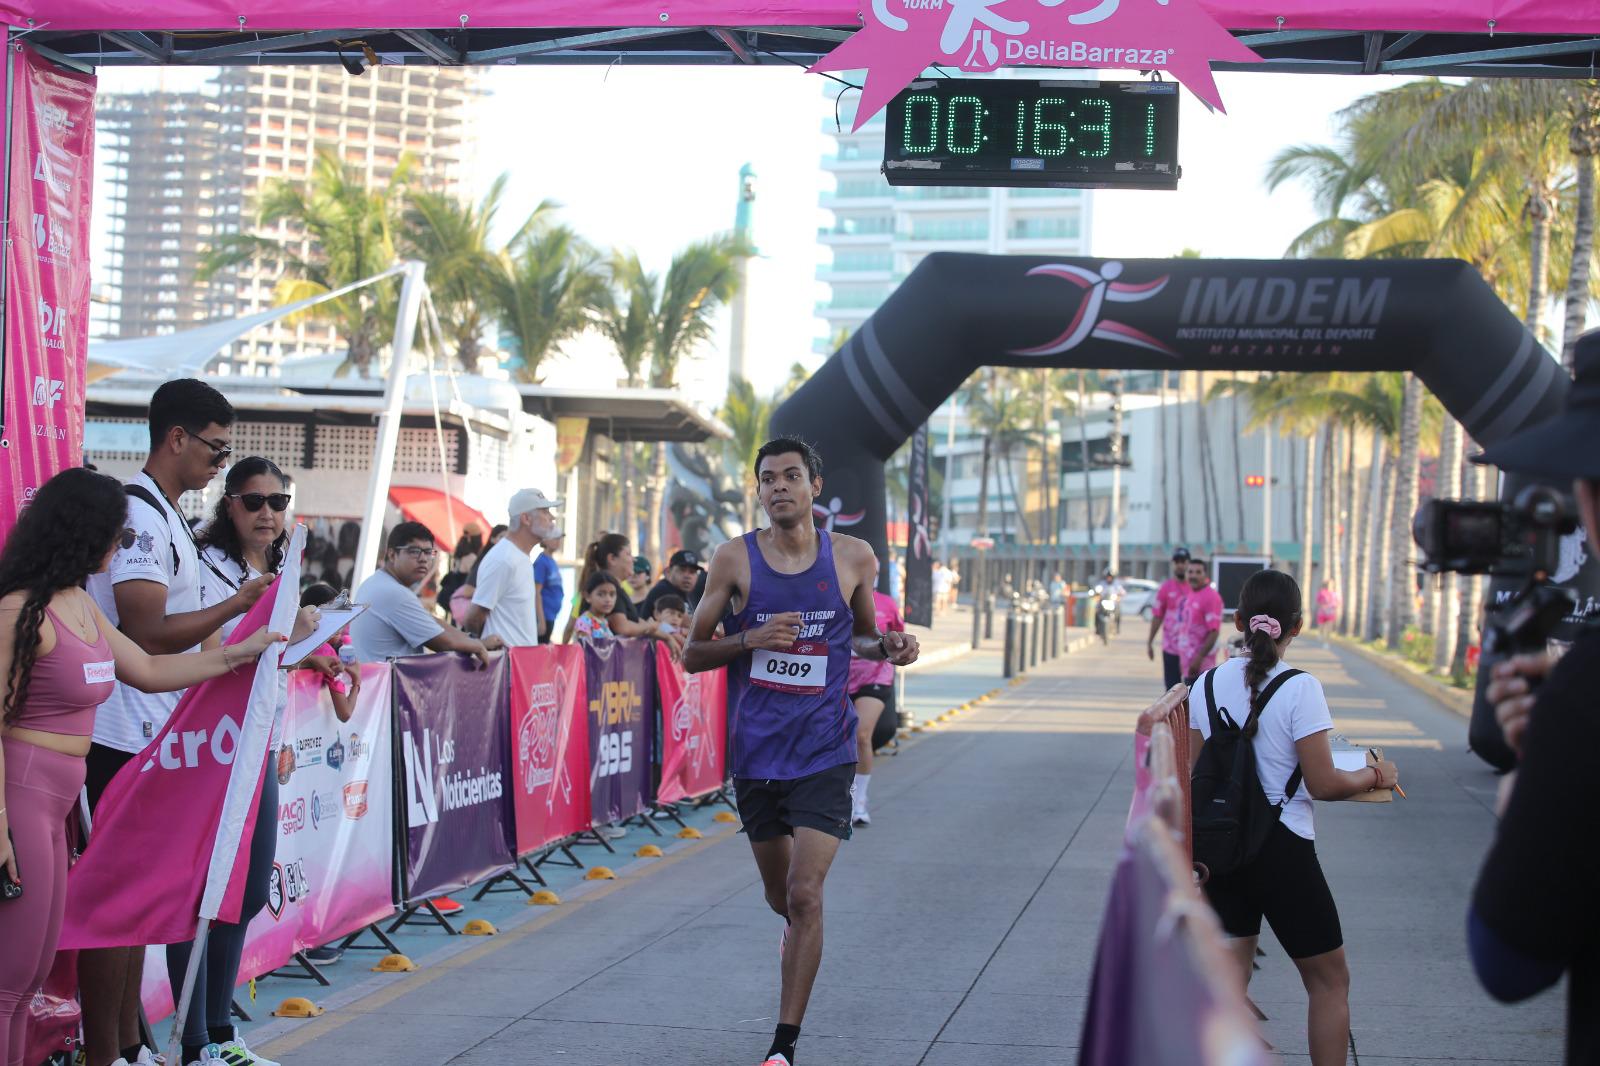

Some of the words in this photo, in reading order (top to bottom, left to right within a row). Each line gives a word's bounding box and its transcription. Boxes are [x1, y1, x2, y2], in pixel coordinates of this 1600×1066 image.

[1178, 277, 1391, 325] IMDEM
[1176, 328, 1236, 339] INSTITUTO
[1238, 328, 1299, 339] MUNICIPAL
[1302, 329, 1323, 339] DEL
[1325, 329, 1376, 339] DEPORTE
[766, 659, 812, 678] 0309
[436, 733, 455, 765] Los
